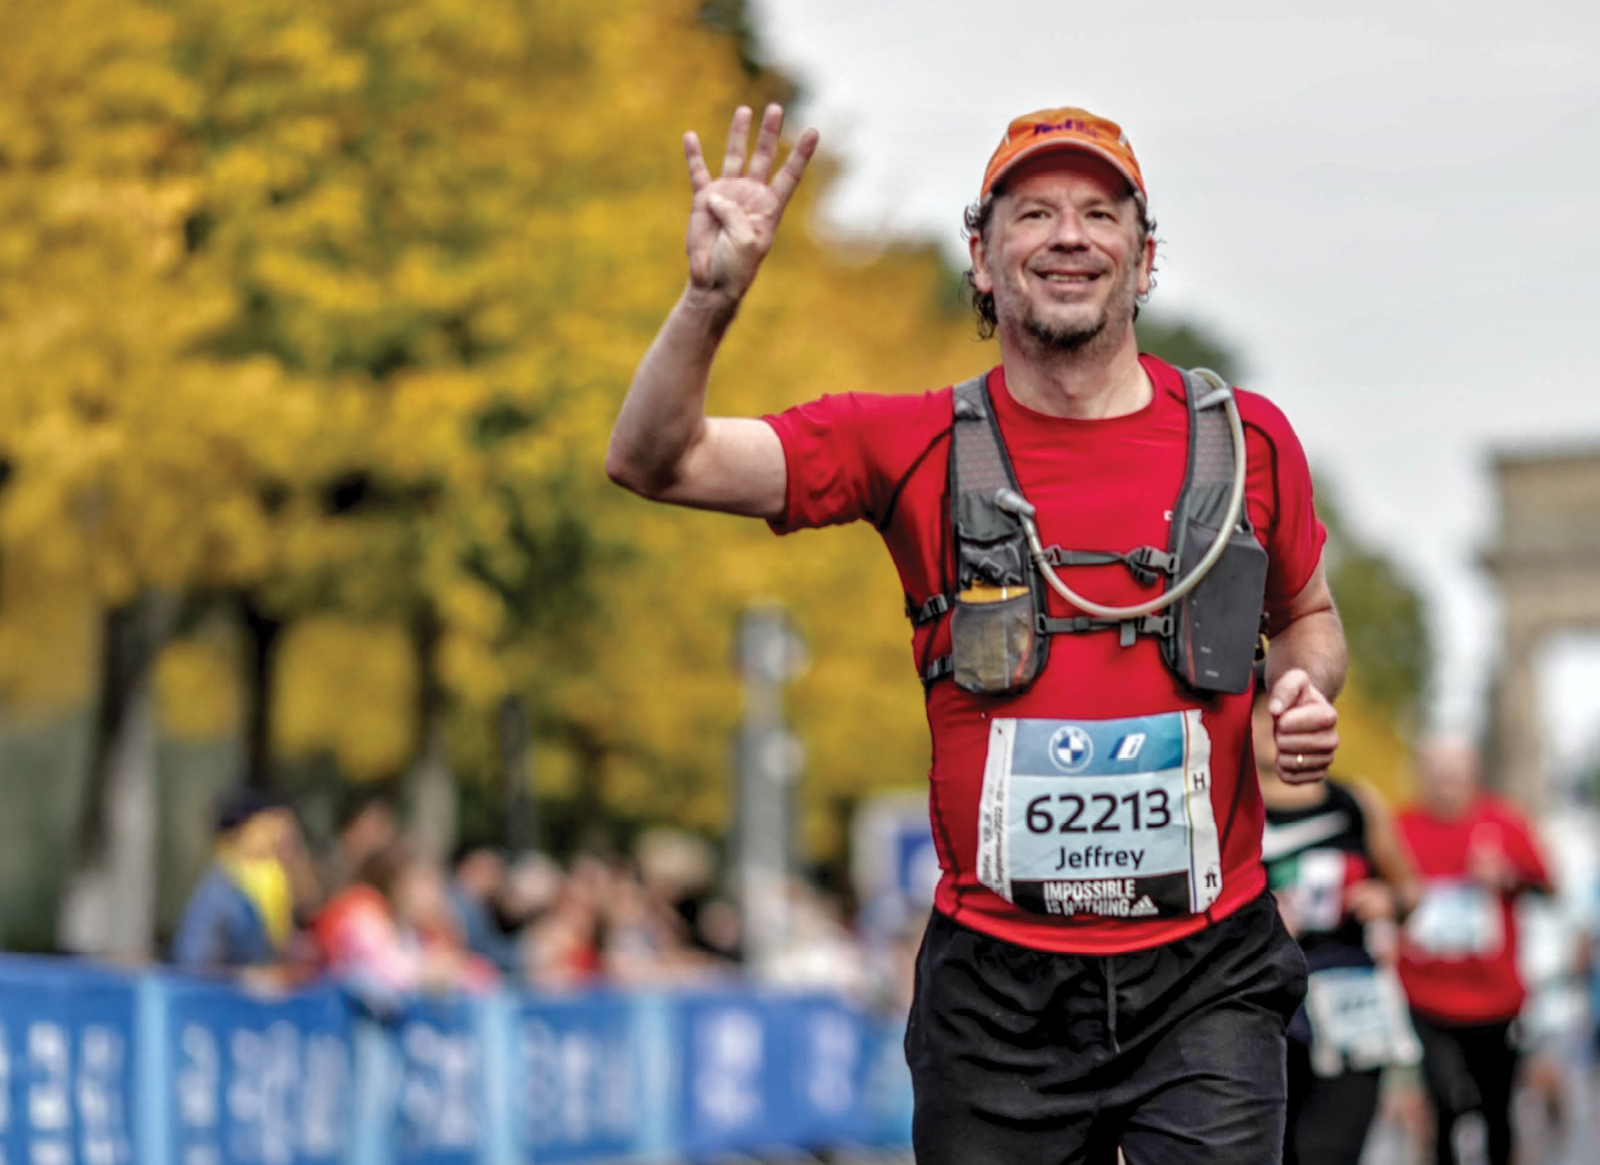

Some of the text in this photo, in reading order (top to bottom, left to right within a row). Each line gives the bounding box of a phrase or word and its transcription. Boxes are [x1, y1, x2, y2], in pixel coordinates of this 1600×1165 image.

[1193, 772, 1206, 791] H
[1025, 788, 1171, 835] 62213
[1055, 845, 1146, 871] Jeffrey
[1043, 879, 1136, 901] IMPOSSIBLE
[1045, 899, 1062, 914] IS
